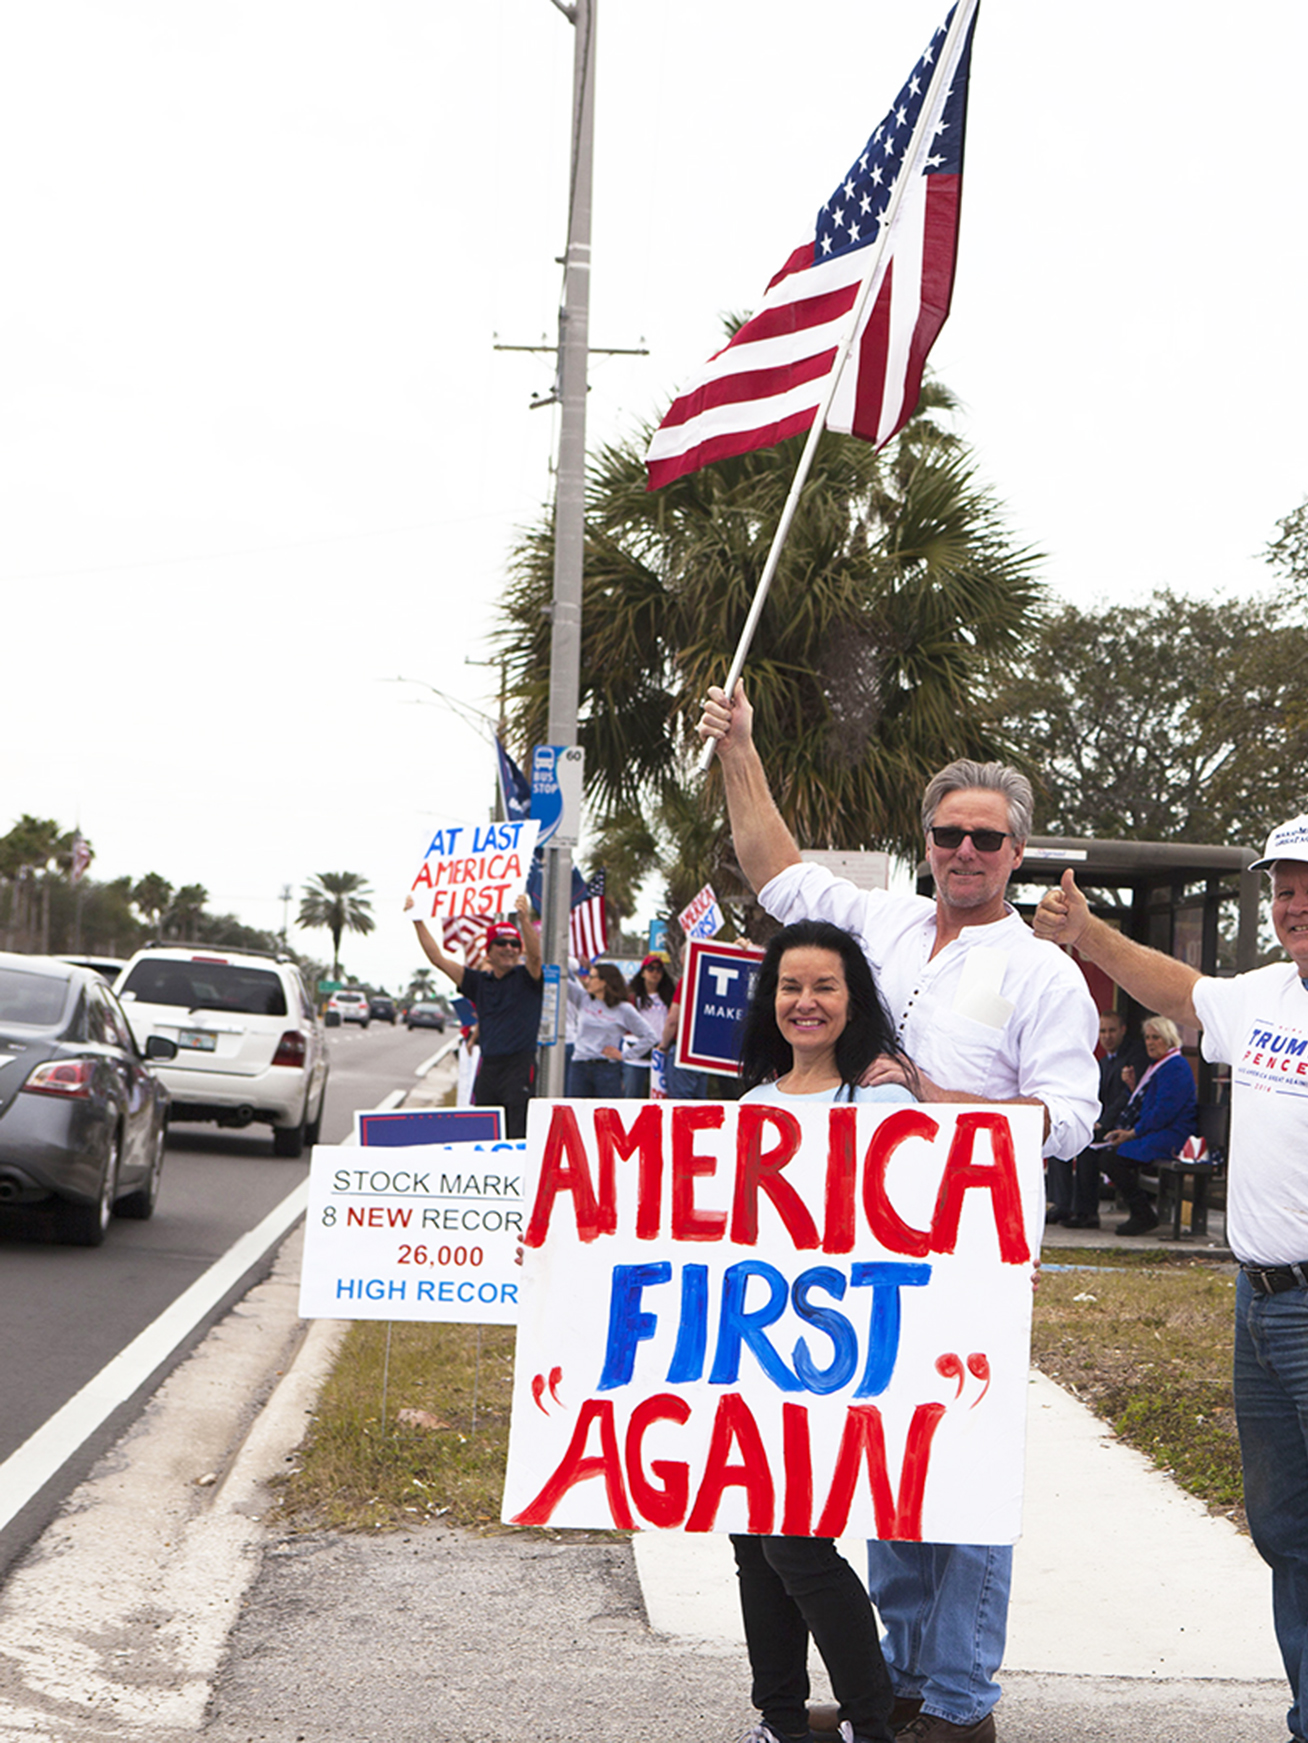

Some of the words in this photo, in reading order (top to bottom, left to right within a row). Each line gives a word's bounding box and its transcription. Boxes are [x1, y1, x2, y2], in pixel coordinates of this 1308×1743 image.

[566, 750, 582, 761] 60
[533, 783, 558, 795] STOP
[534, 771, 554, 783] BUS
[424, 828, 464, 859] AT
[472, 822, 525, 854] LAST
[411, 853, 522, 891] AMERICA
[431, 883, 512, 918] FIRST
[703, 1003, 744, 1021] MAKE
[1242, 1050, 1308, 1076] PENCE
[332, 1169, 430, 1194] STOCK
[440, 1173, 525, 1197] MARK
[523, 1105, 1031, 1265] AMERICA
[322, 1206, 337, 1228] 8
[347, 1206, 413, 1228] NEW
[397, 1244, 484, 1270] 26,000
[336, 1277, 407, 1301] HIGH
[597, 1260, 932, 1399] FIRST
